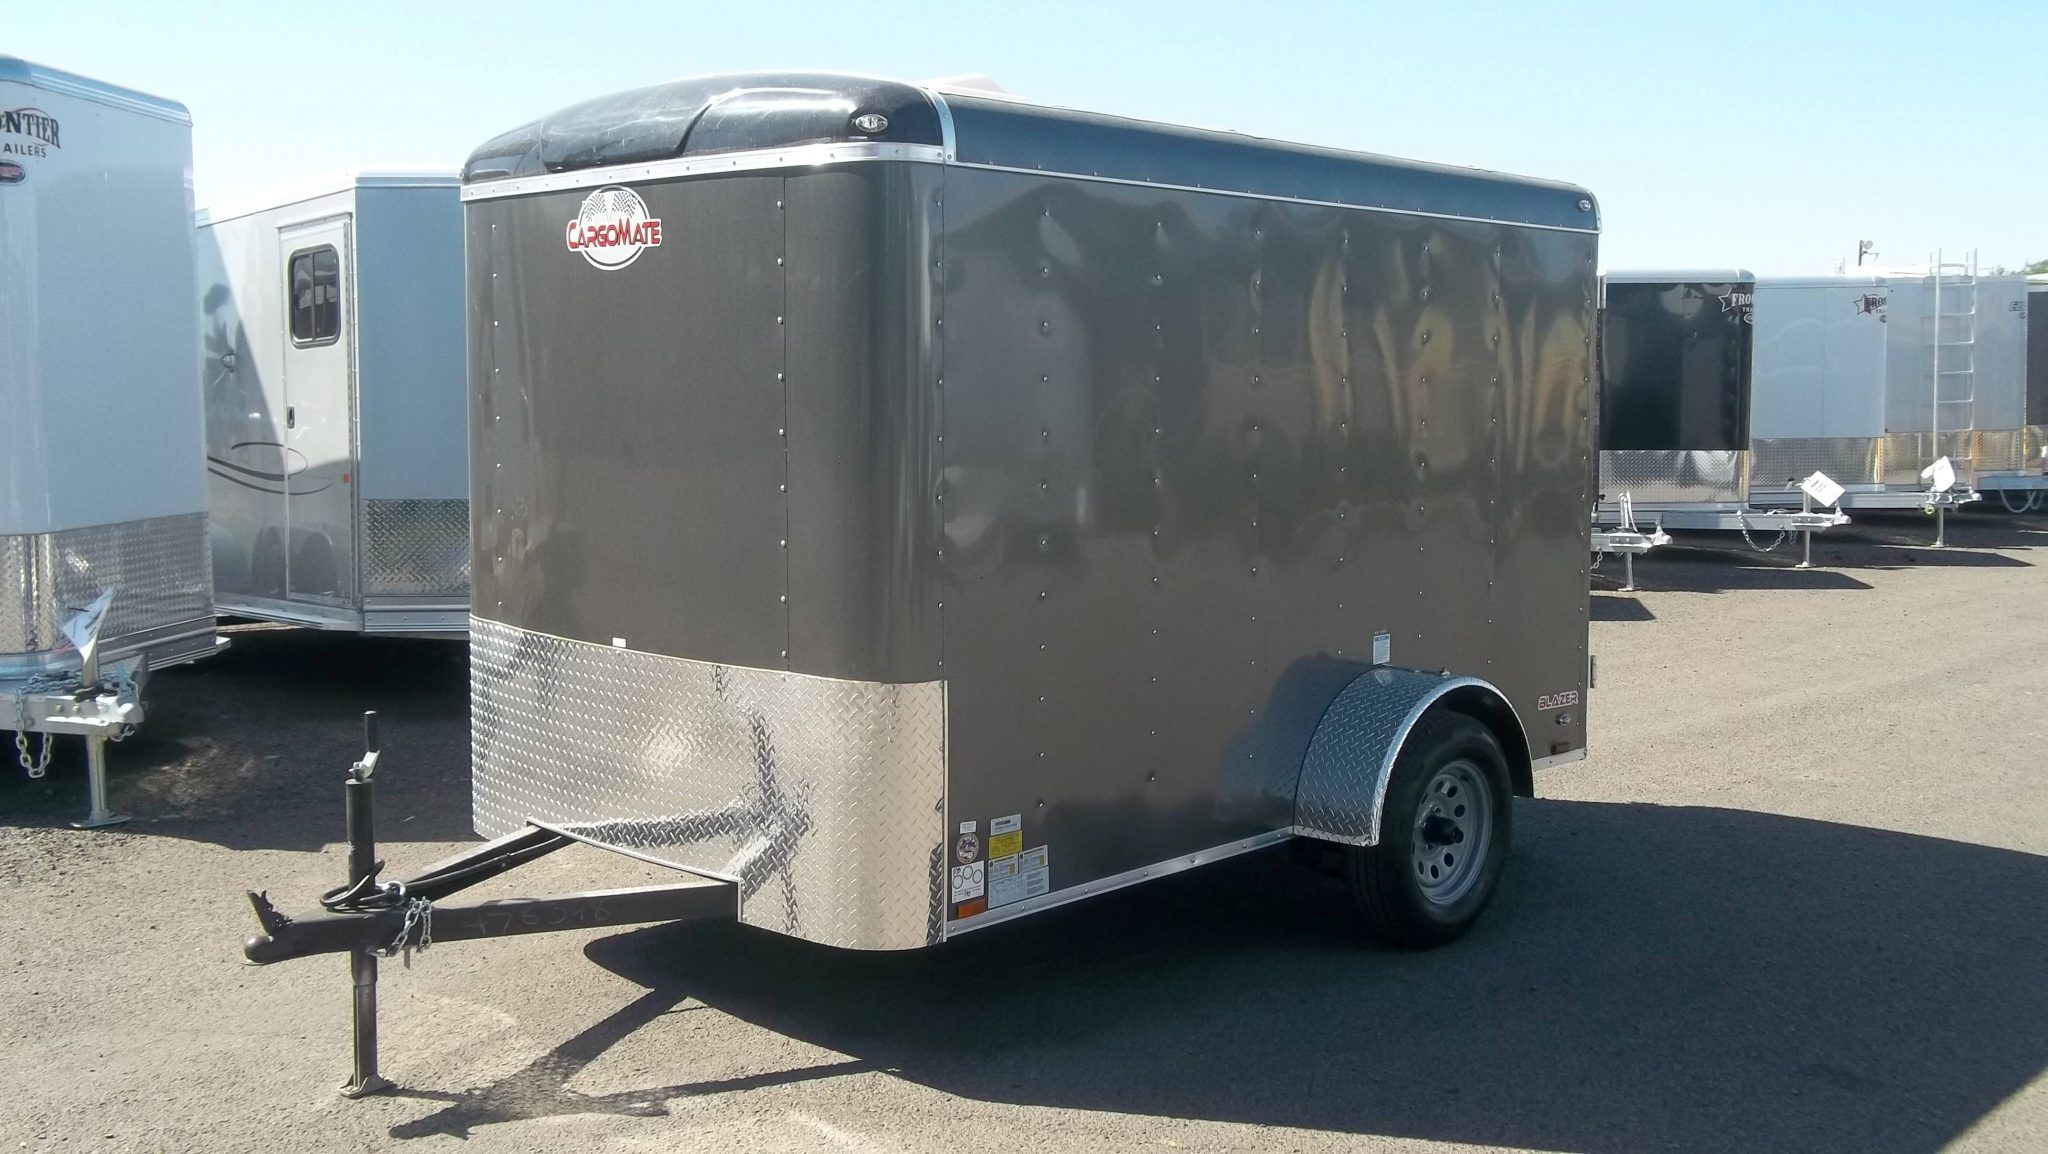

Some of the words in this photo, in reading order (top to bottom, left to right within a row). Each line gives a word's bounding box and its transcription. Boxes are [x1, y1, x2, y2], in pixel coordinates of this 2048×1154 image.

[0, 111, 61, 149] NTIER
[567, 218, 661, 249] CARGOMATE
[1731, 292, 1754, 306] FRO
[1538, 691, 1578, 710] BLAZER
